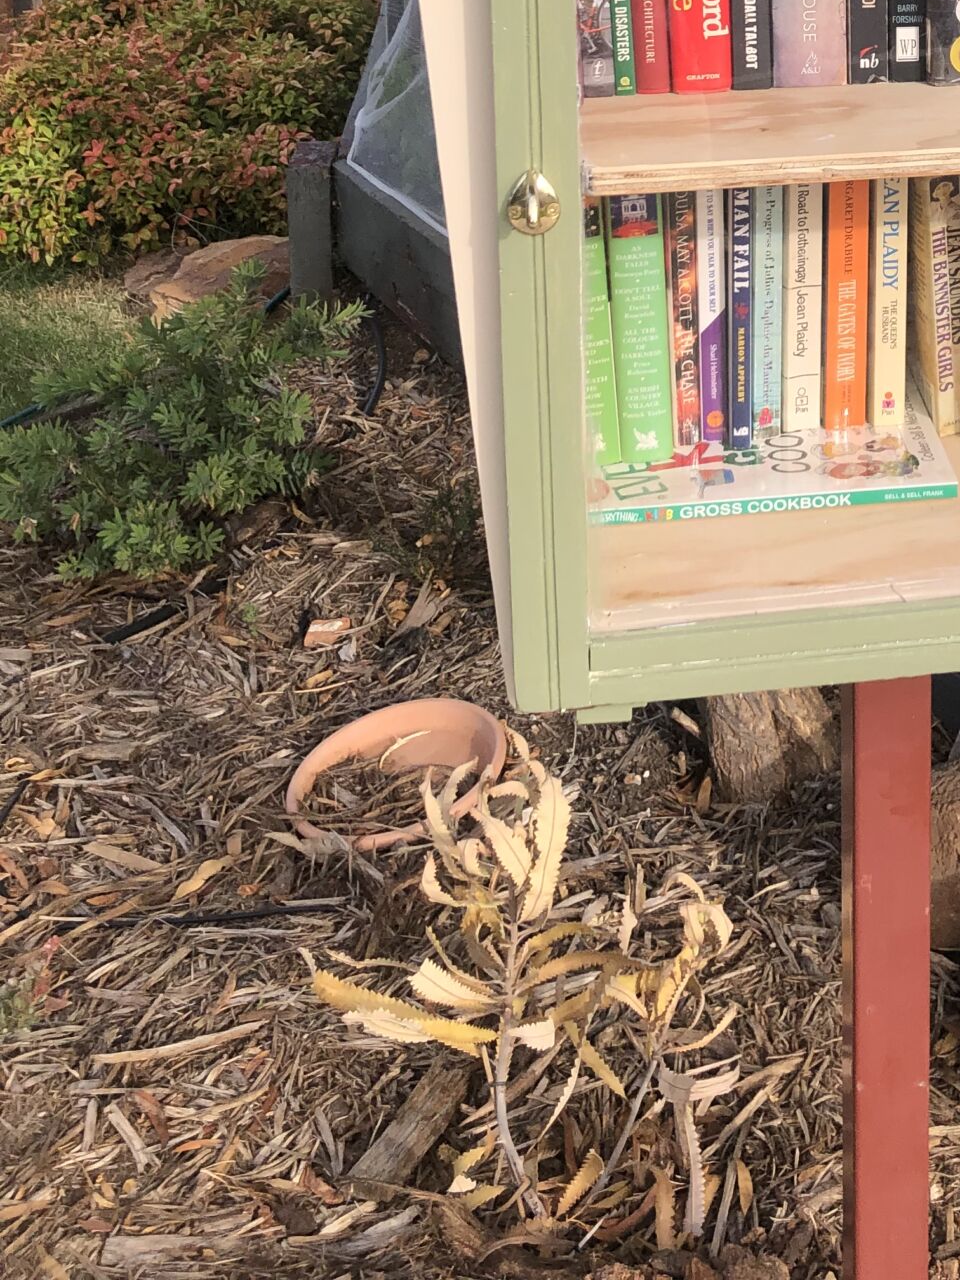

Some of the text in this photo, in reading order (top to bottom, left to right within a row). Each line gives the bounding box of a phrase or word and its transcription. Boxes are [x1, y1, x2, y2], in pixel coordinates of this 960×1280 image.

[892, 15, 924, 23] FORSHAW
[897, 4, 918, 13] BARRY
[616, 7, 631, 63] DISASTERS
[744, 26, 758, 69] TALBOT
[899, 38, 917, 50] WP
[797, 190, 809, 215] Road
[763, 200, 776, 248] Progress
[797, 216, 809, 227] to
[733, 190, 750, 293] MAN FAIL
[765, 250, 775, 262] of
[795, 227, 809, 284] Fotheringay
[844, 225, 853, 275] DRABBLE
[882, 221, 899, 292] PLAIDY
[764, 263, 775, 295] Julius
[838, 279, 857, 302] THE
[677, 235, 696, 404] MAY ALCOTT CHASE
[796, 289, 809, 320] Jean
[837, 303, 856, 333] GATES
[931, 227, 954, 393] THE BANNISTER GIRLS
[761, 300, 774, 343] Daphne
[881, 306, 890, 344] HUSBAND
[763, 345, 773, 359] du
[793, 321, 809, 358] Plaidy
[838, 336, 856, 349] OF
[837, 352, 856, 382] IVORY
[763, 361, 773, 405] Maurier
[680, 493, 852, 519] GROSS COOKBOOK
[922, 489, 944, 498] FRANK
